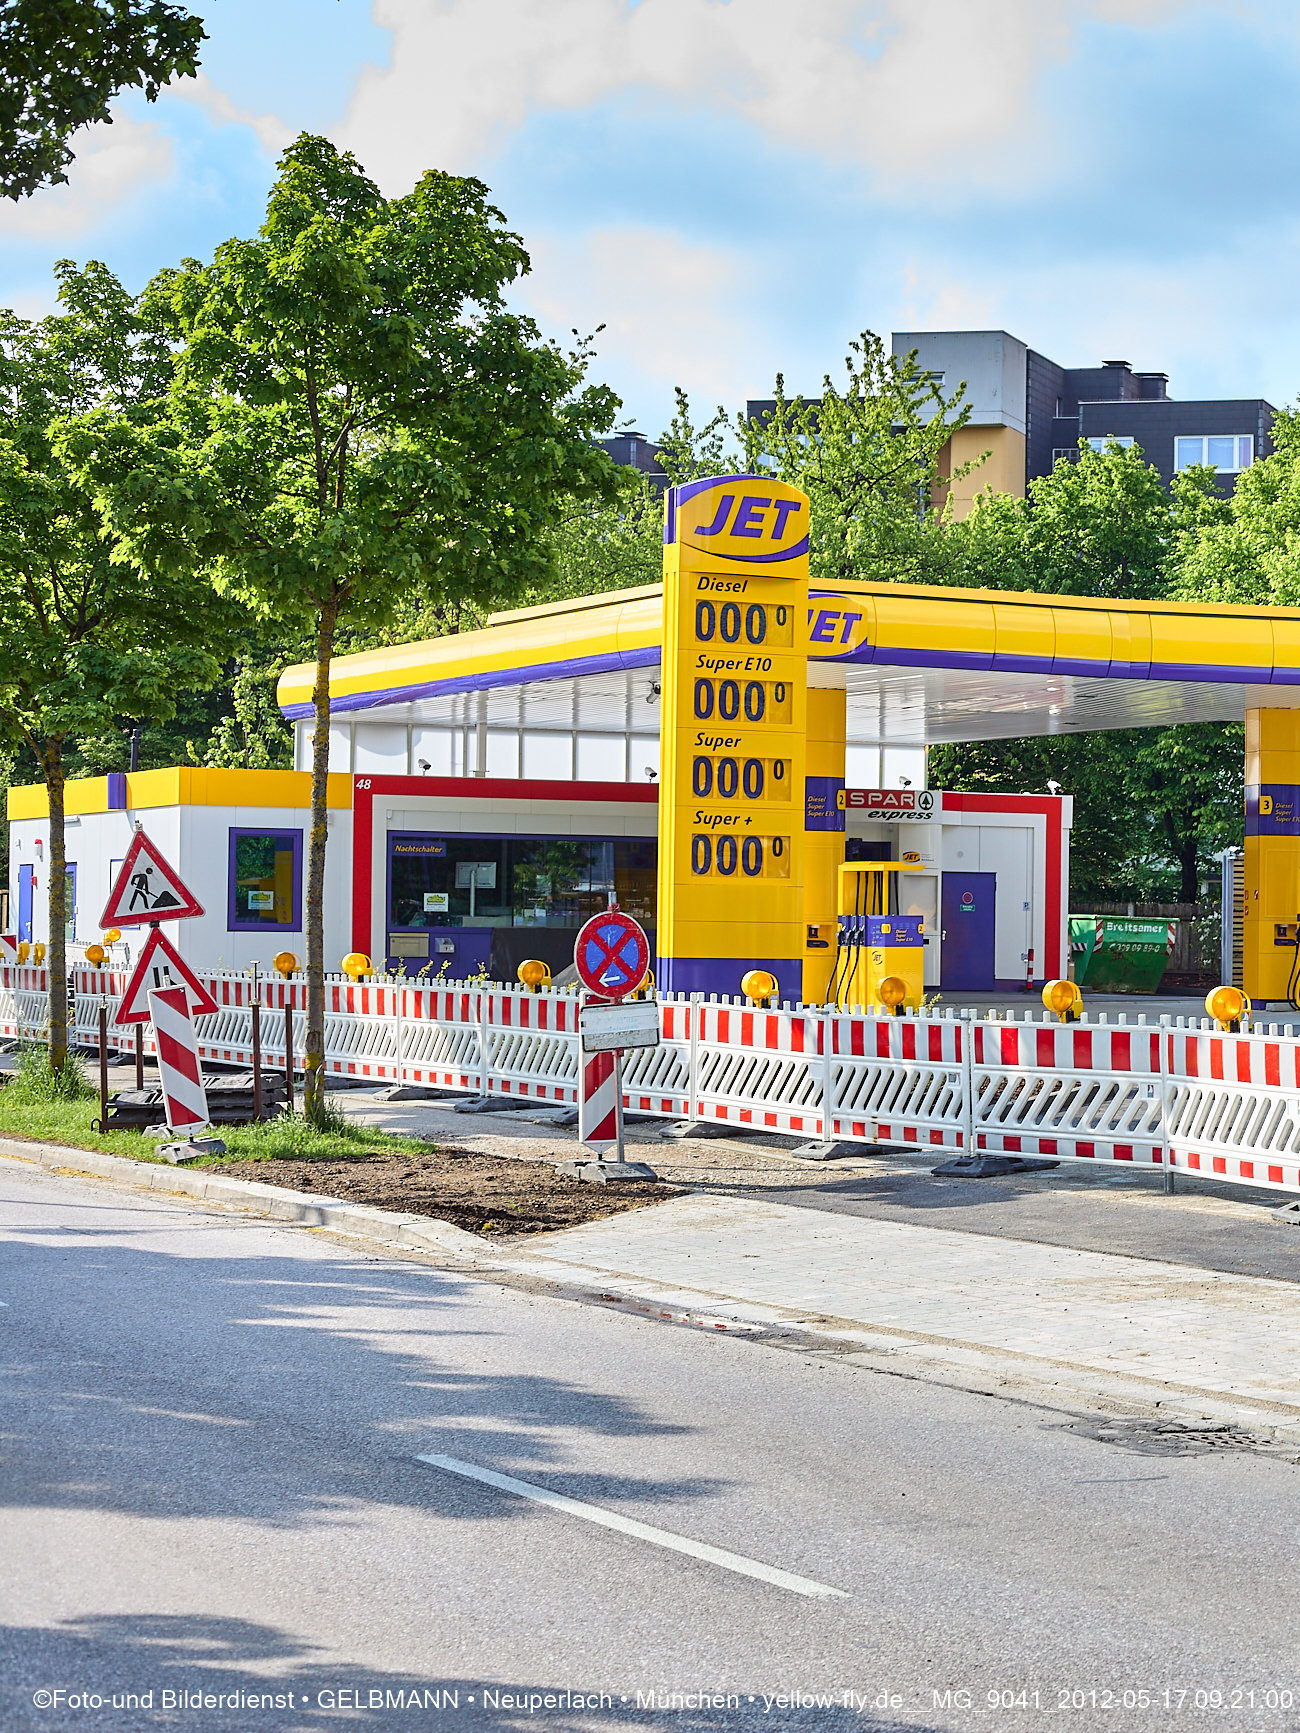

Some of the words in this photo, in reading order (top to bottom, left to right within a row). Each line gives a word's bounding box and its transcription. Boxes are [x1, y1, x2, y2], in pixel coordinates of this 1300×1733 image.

[694, 495, 802, 540] JET
[697, 576, 748, 593] Diesel
[695, 654, 742, 673] Super
[745, 657, 772, 672] E10
[694, 732, 742, 751] Super
[356, 778, 372, 790] 48
[839, 795, 844, 805] 2
[850, 792, 914, 806] SPAR
[1263, 800, 1270, 810] 3
[693, 810, 740, 829] Super
[867, 810, 933, 821] express
[395, 844, 443, 853] Nachtschalter
[1106, 922, 1164, 933] Breitsamer
